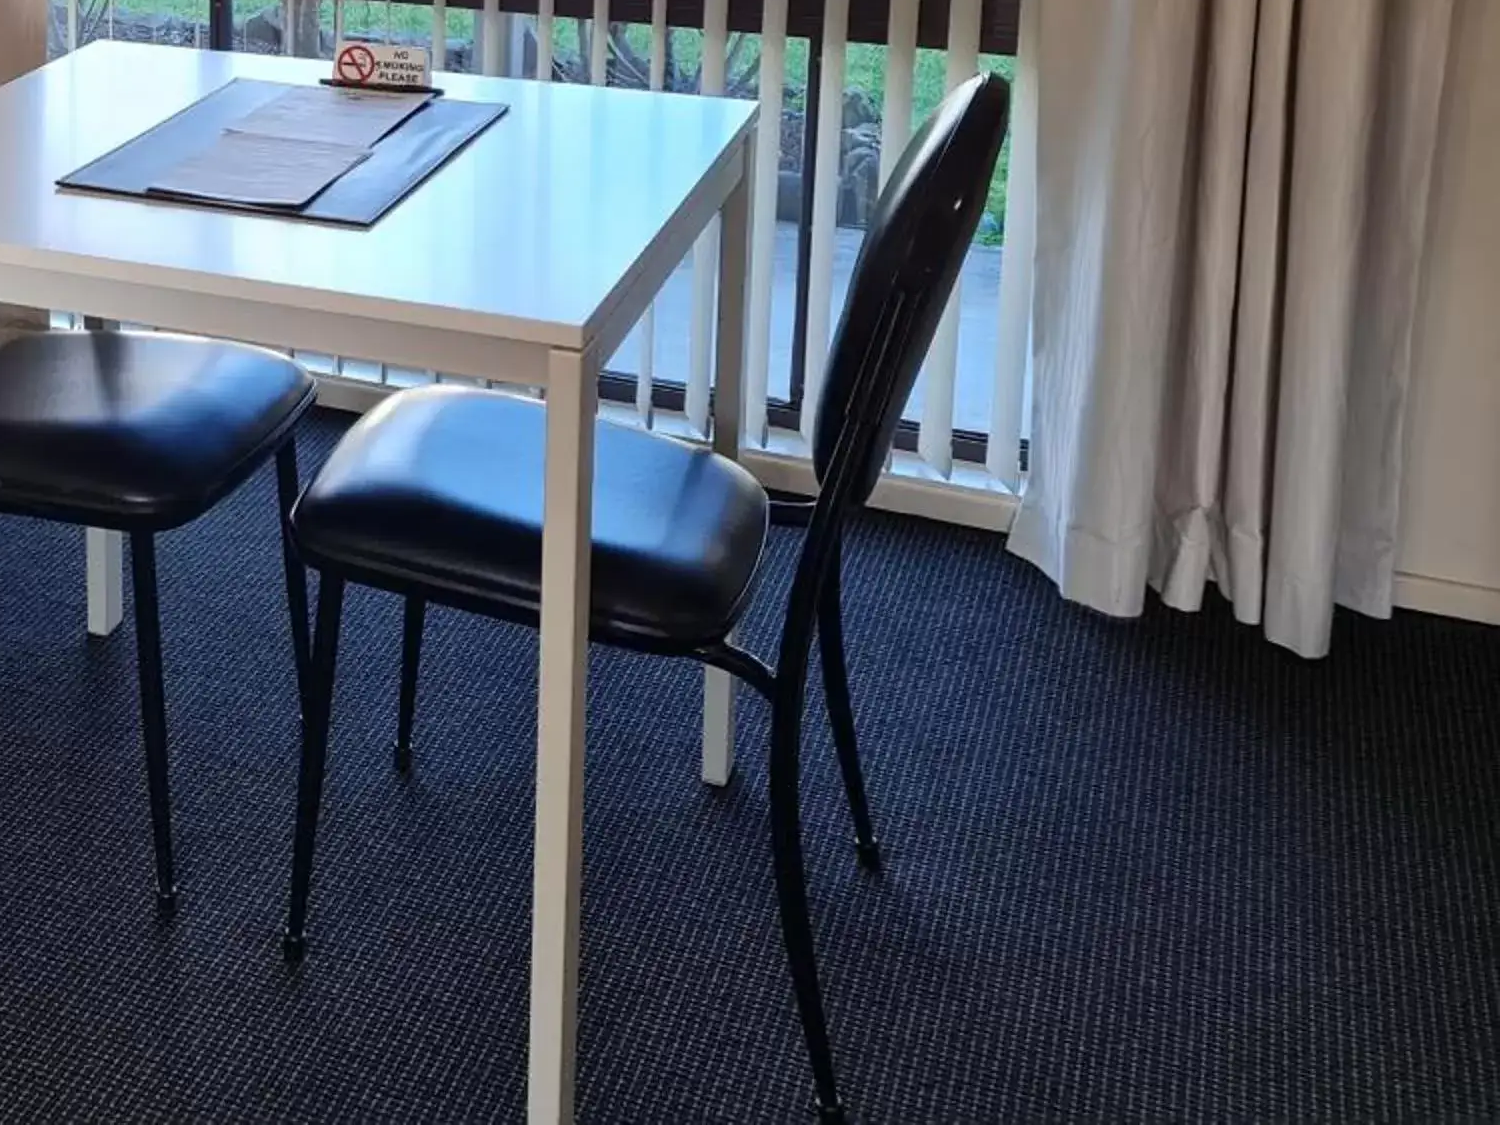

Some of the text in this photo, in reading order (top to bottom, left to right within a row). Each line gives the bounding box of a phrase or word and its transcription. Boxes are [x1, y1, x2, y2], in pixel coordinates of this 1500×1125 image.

[392, 50, 409, 59] NO
[375, 60, 423, 72] SMOKING
[378, 70, 418, 82] PLEASE
